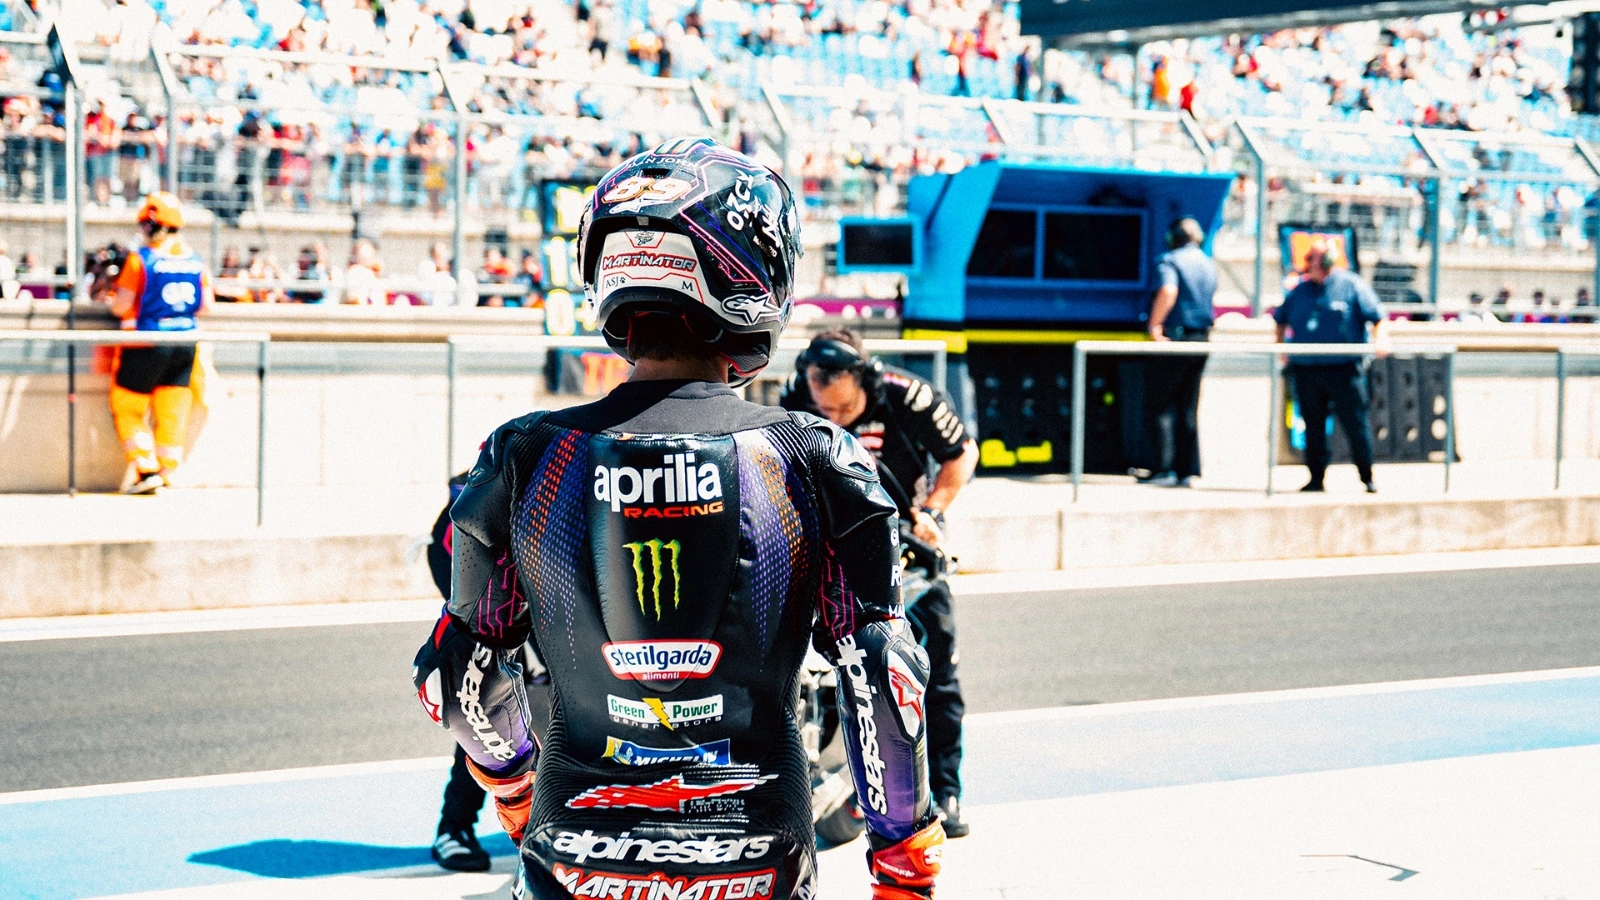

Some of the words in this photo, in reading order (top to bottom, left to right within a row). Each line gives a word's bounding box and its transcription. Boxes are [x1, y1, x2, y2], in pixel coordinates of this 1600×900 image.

[601, 176, 692, 204] 89
[602, 252, 696, 271] MARTINATOR
[605, 276, 619, 289] ASJ
[681, 280, 694, 291] M
[593, 452, 723, 513] aprilia
[623, 501, 724, 519] RACING
[610, 644, 712, 671] sterilgarda
[642, 671, 680, 680] alimenti
[456, 641, 517, 762] alpinestars
[610, 698, 646, 719] Green
[672, 702, 718, 719] Power
[836, 633, 888, 816] alpinestars
[553, 830, 775, 865] alpinestars
